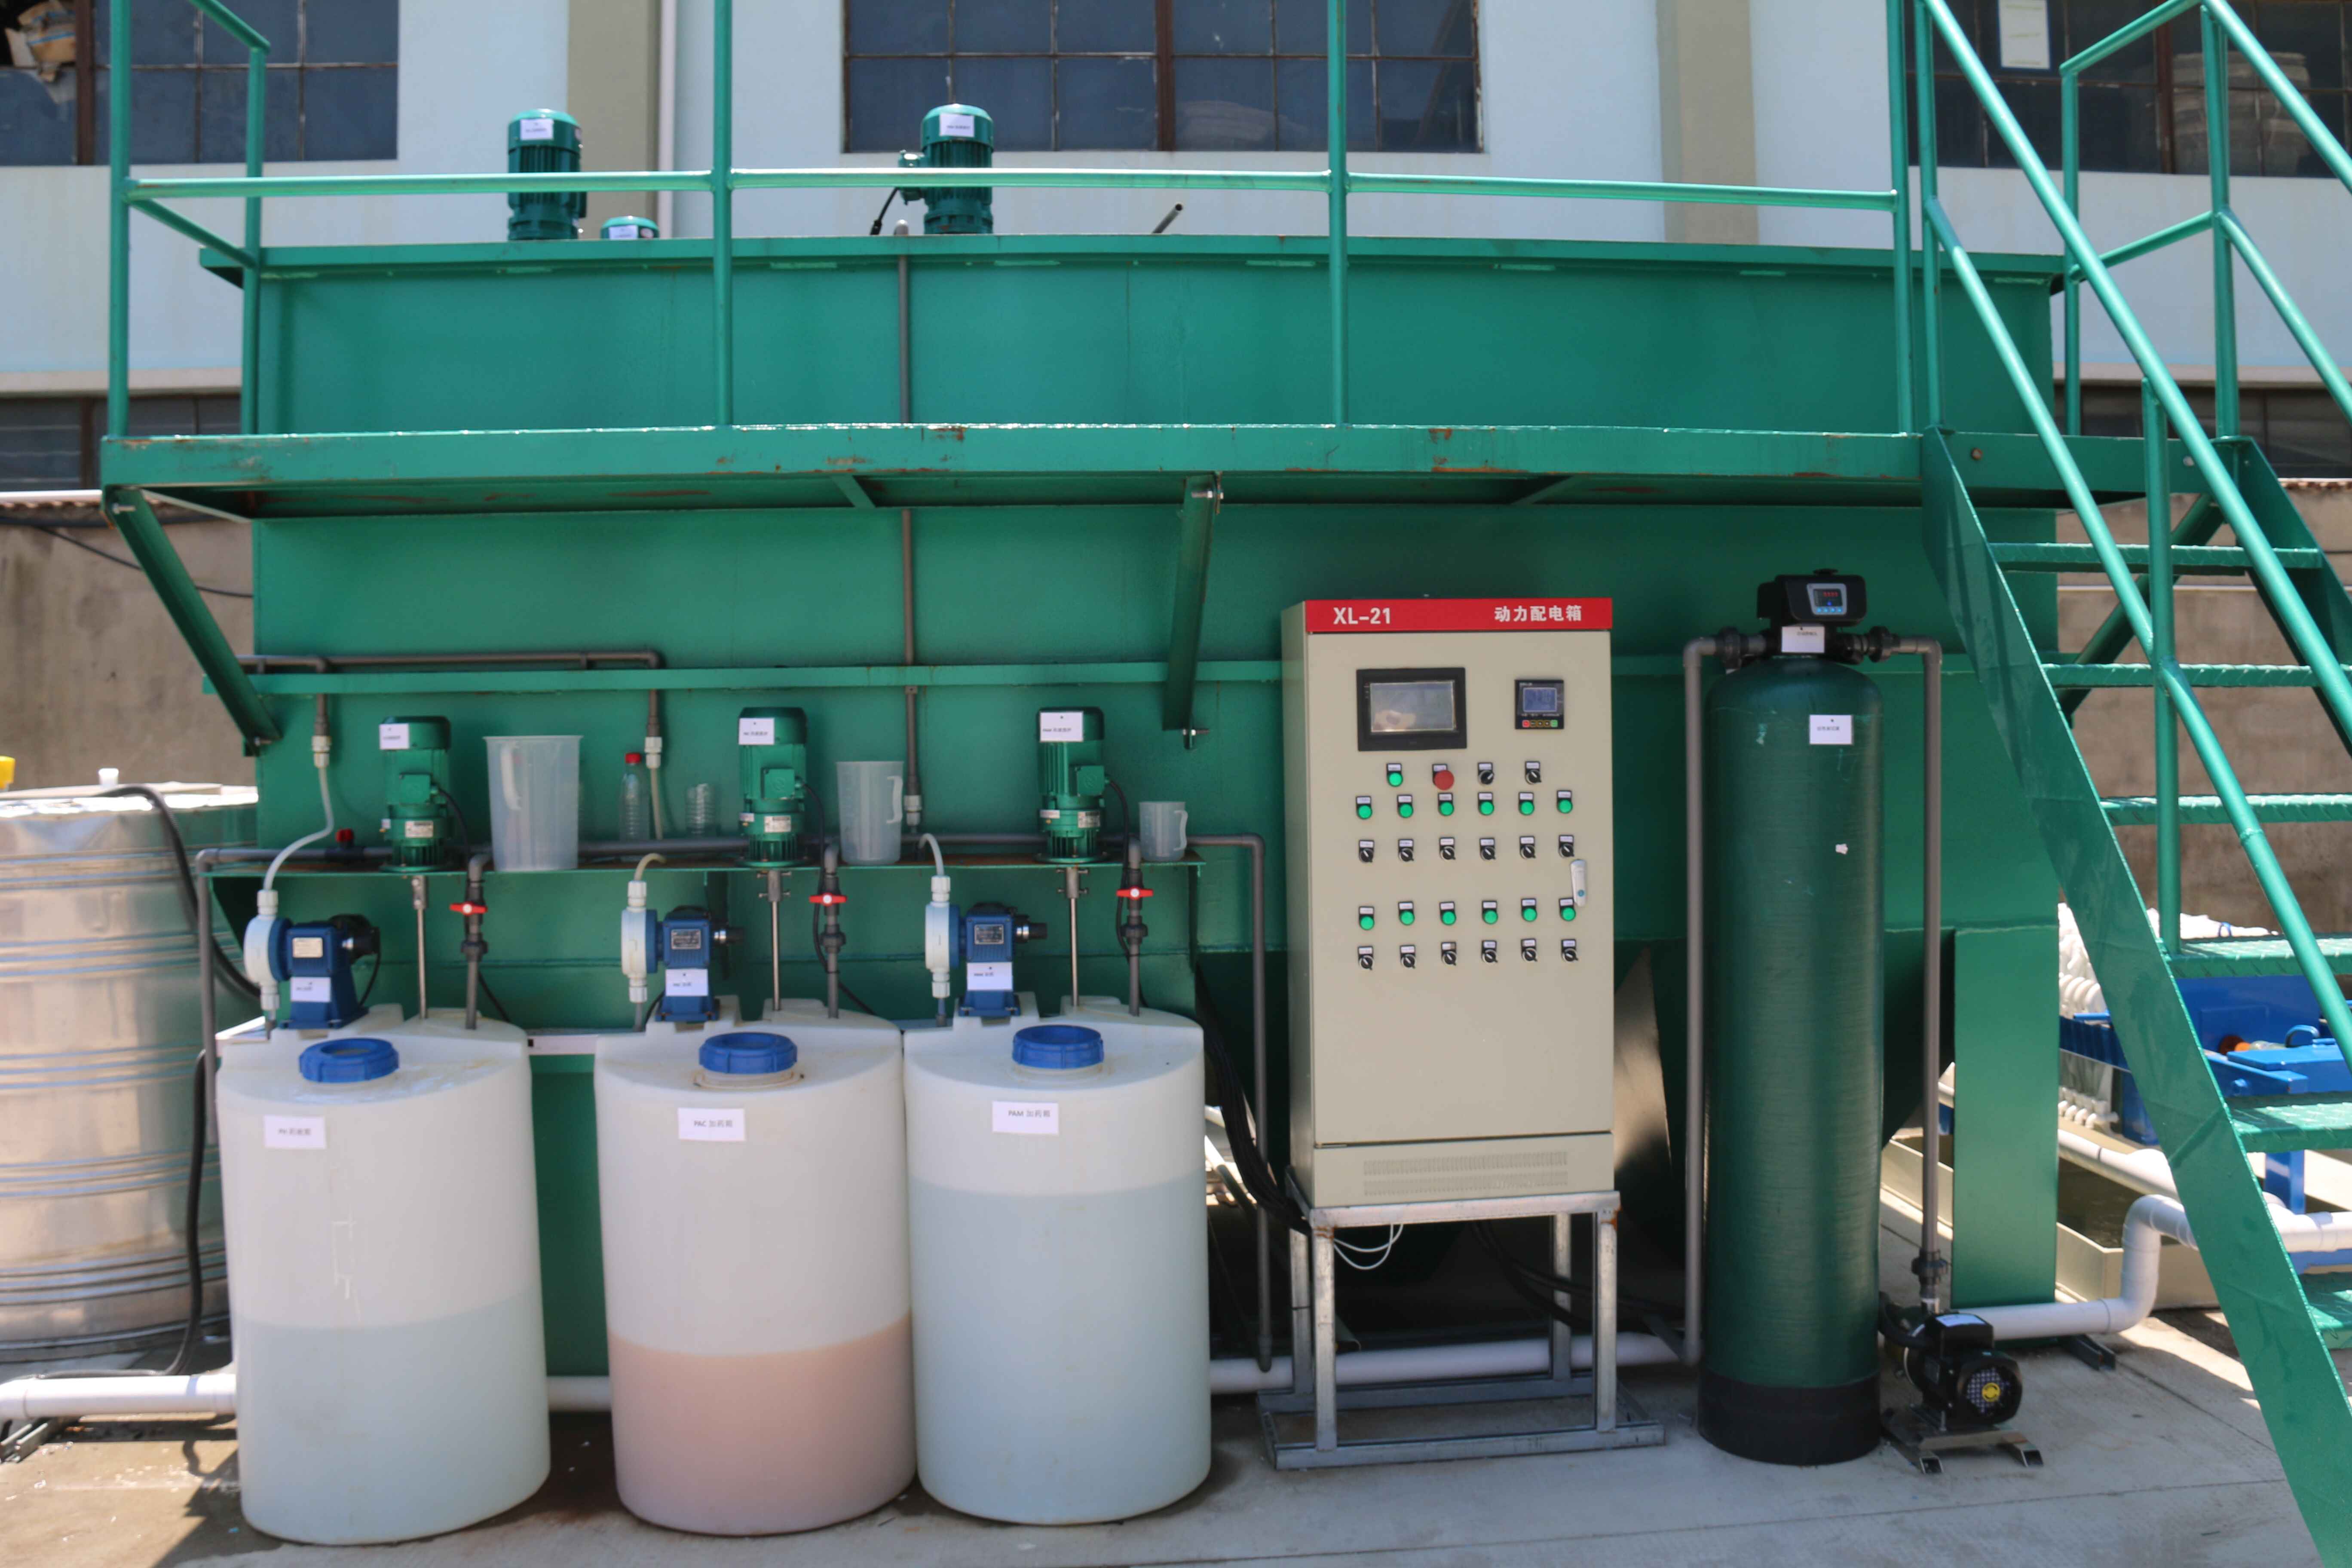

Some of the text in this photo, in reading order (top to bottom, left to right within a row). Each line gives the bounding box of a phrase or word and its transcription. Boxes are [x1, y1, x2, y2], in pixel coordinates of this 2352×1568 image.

[1333, 607, 1390, 625] XL-21
[1494, 605, 1582, 622] 动力配电箱
